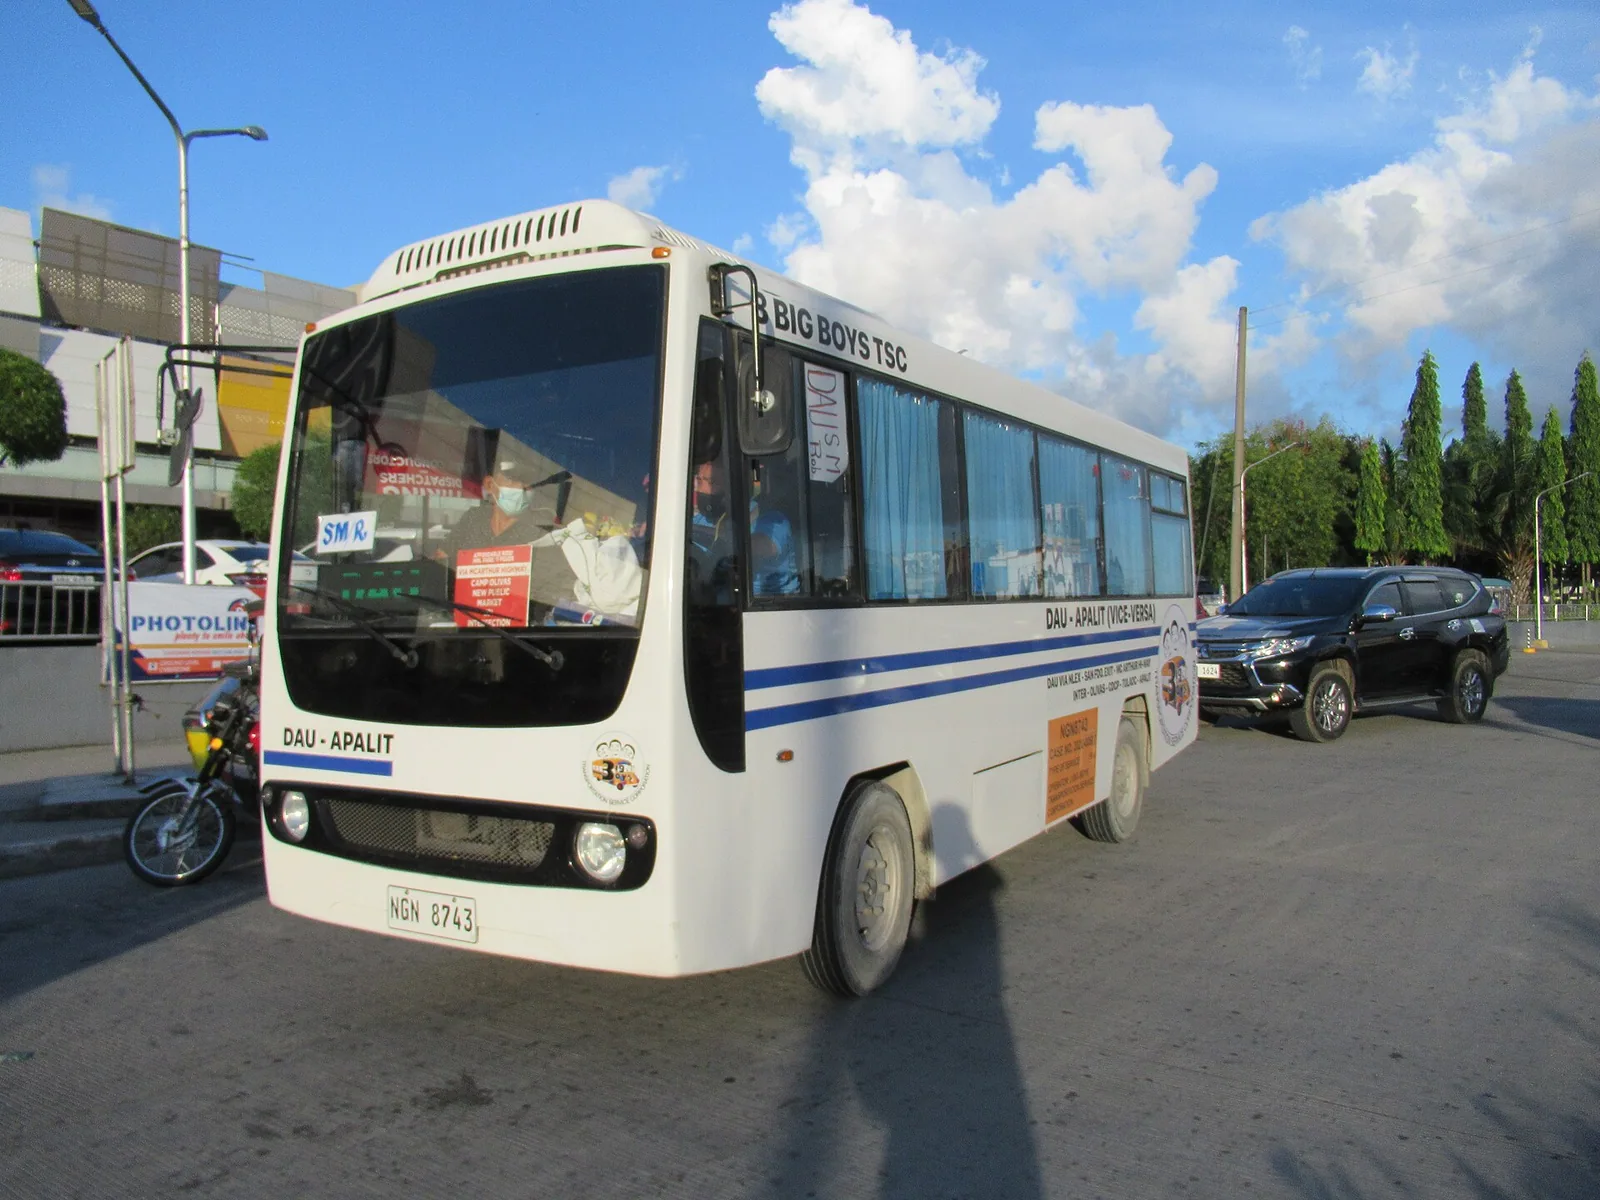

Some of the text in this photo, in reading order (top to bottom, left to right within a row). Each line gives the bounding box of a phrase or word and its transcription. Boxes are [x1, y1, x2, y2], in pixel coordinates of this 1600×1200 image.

[773, 298, 813, 340] BIG
[817, 314, 870, 360] BOYS
[872, 336, 907, 373] TSC
[807, 369, 839, 429] DAU
[380, 472, 463, 489] DISPATCHERS
[471, 577, 511, 587] CAMP OLIVAS
[472, 587, 510, 597] NEW PUBLIC
[476, 598, 502, 606] MARKET
[131, 615, 257, 632] PHOTOLIN
[1046, 607, 1067, 630] DAU
[1075, 605, 1105, 627] APALIT
[1107, 603, 1156, 628] (VICE-VERSA)
[1047, 676, 1058, 689] DAU
[1059, 674, 1069, 687] VIA
[1069, 672, 1081, 685] NLEX
[1072, 687, 1087, 701] INTER
[283, 727, 316, 748] DAU
[330, 730, 395, 754] APALIT
[390, 896, 473, 932] NGN 8743
